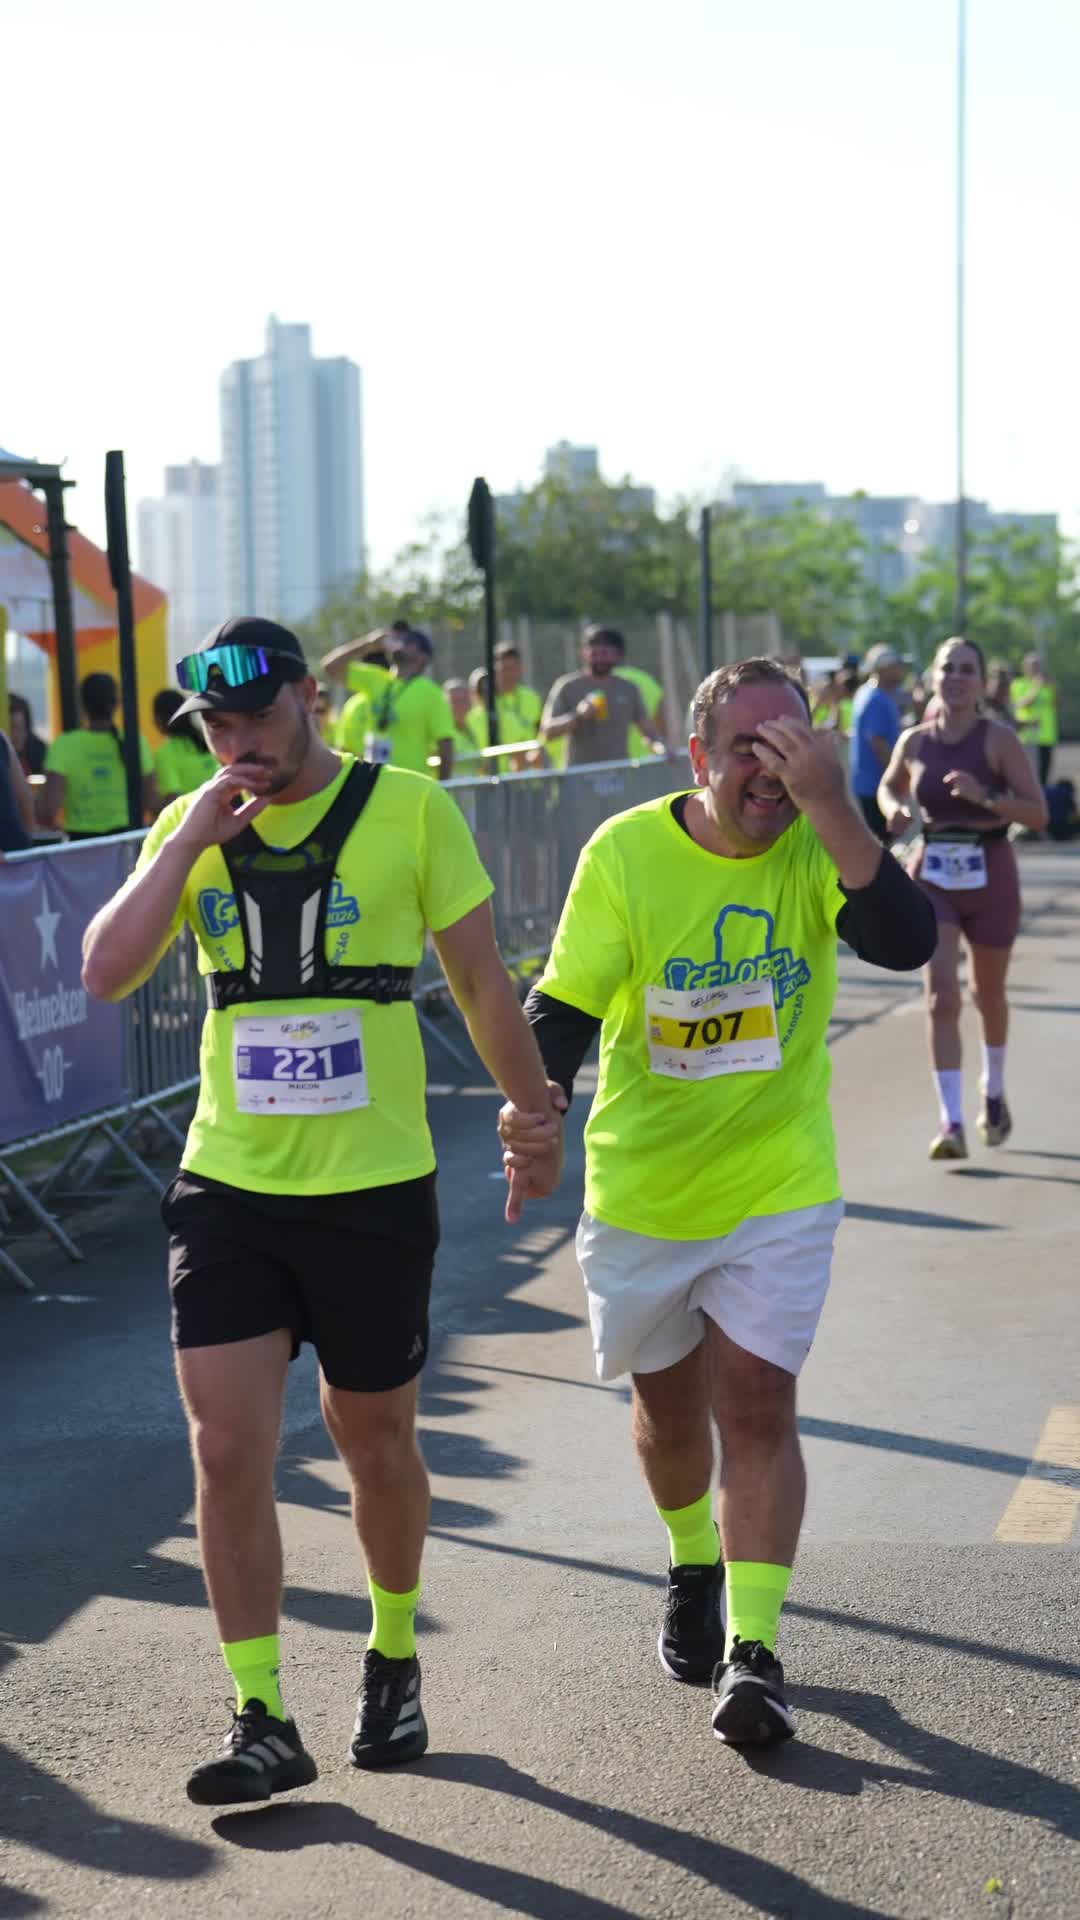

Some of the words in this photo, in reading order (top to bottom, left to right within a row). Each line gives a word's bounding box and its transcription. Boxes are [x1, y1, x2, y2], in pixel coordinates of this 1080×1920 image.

[15, 981, 87, 1039] Heineken
[679, 1012, 743, 1048] 707
[273, 1048, 333, 1080] 221
